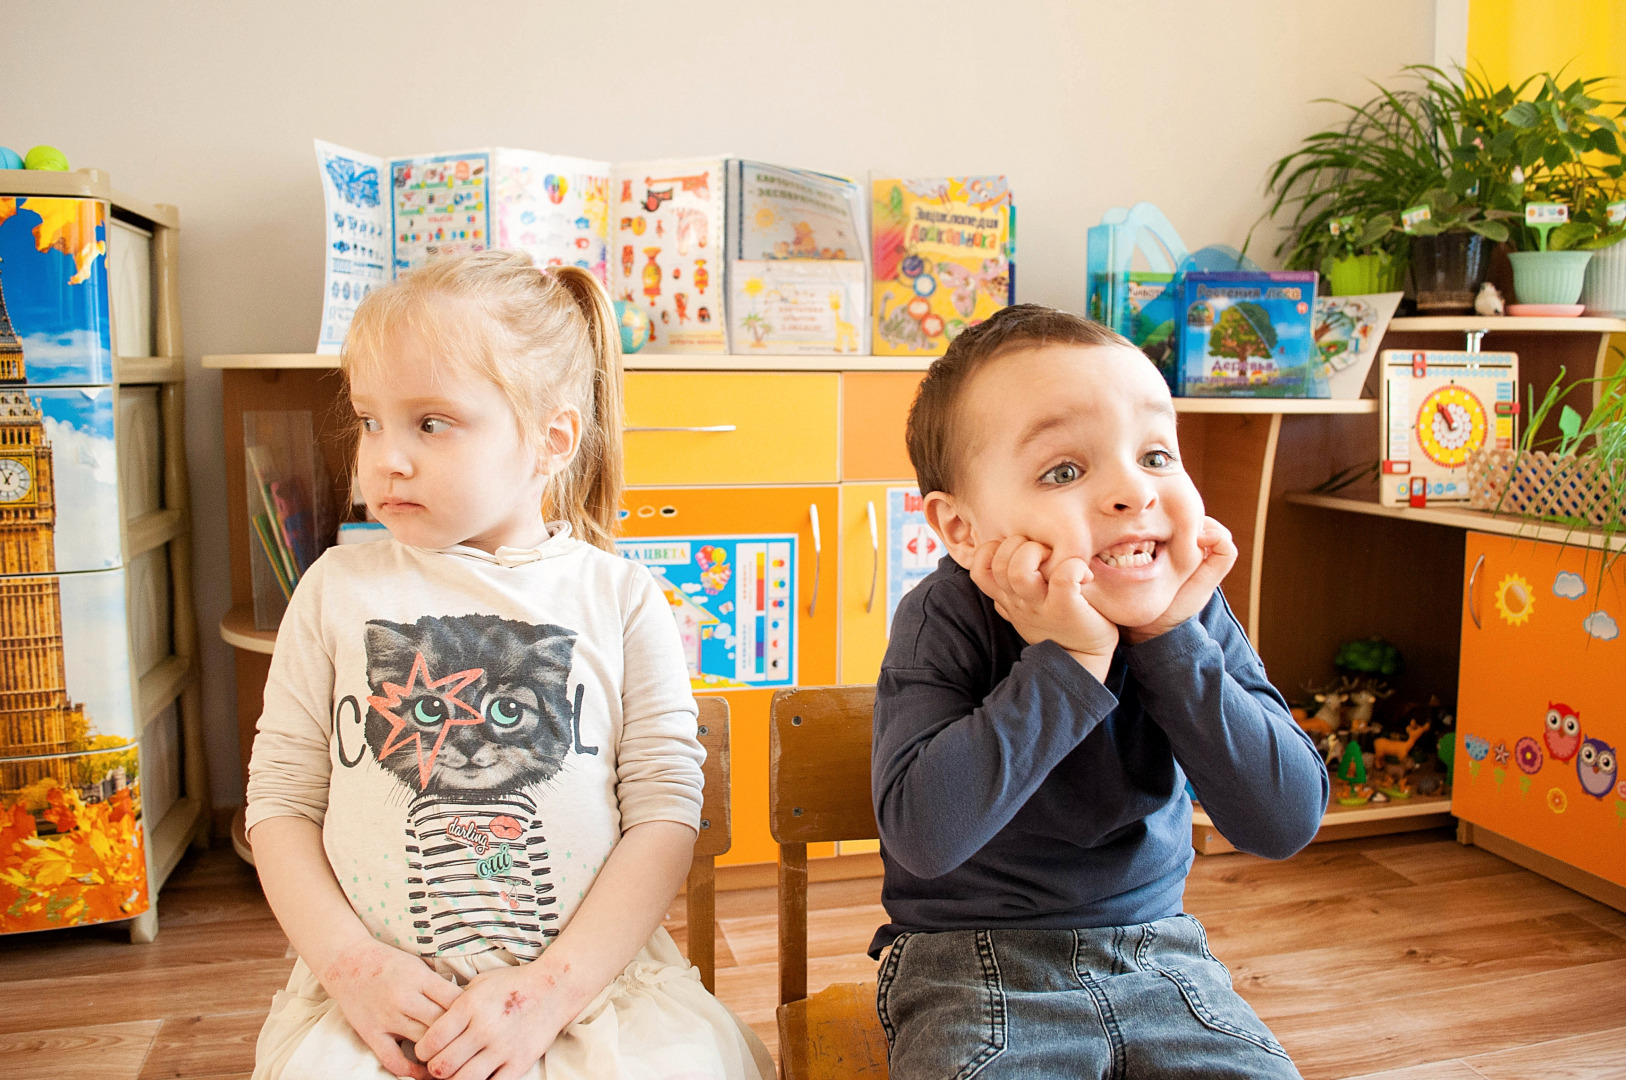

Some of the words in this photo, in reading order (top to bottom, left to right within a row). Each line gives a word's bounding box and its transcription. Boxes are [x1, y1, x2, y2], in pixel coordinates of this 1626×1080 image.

[915, 206, 998, 229] Энциклопедия
[911, 224, 996, 249] Дошкольника
[1198, 283, 1260, 299] Растения
[644, 547, 686, 560] ЦВЕТА
[447, 815, 489, 855] darling
[478, 844, 512, 878] oui
